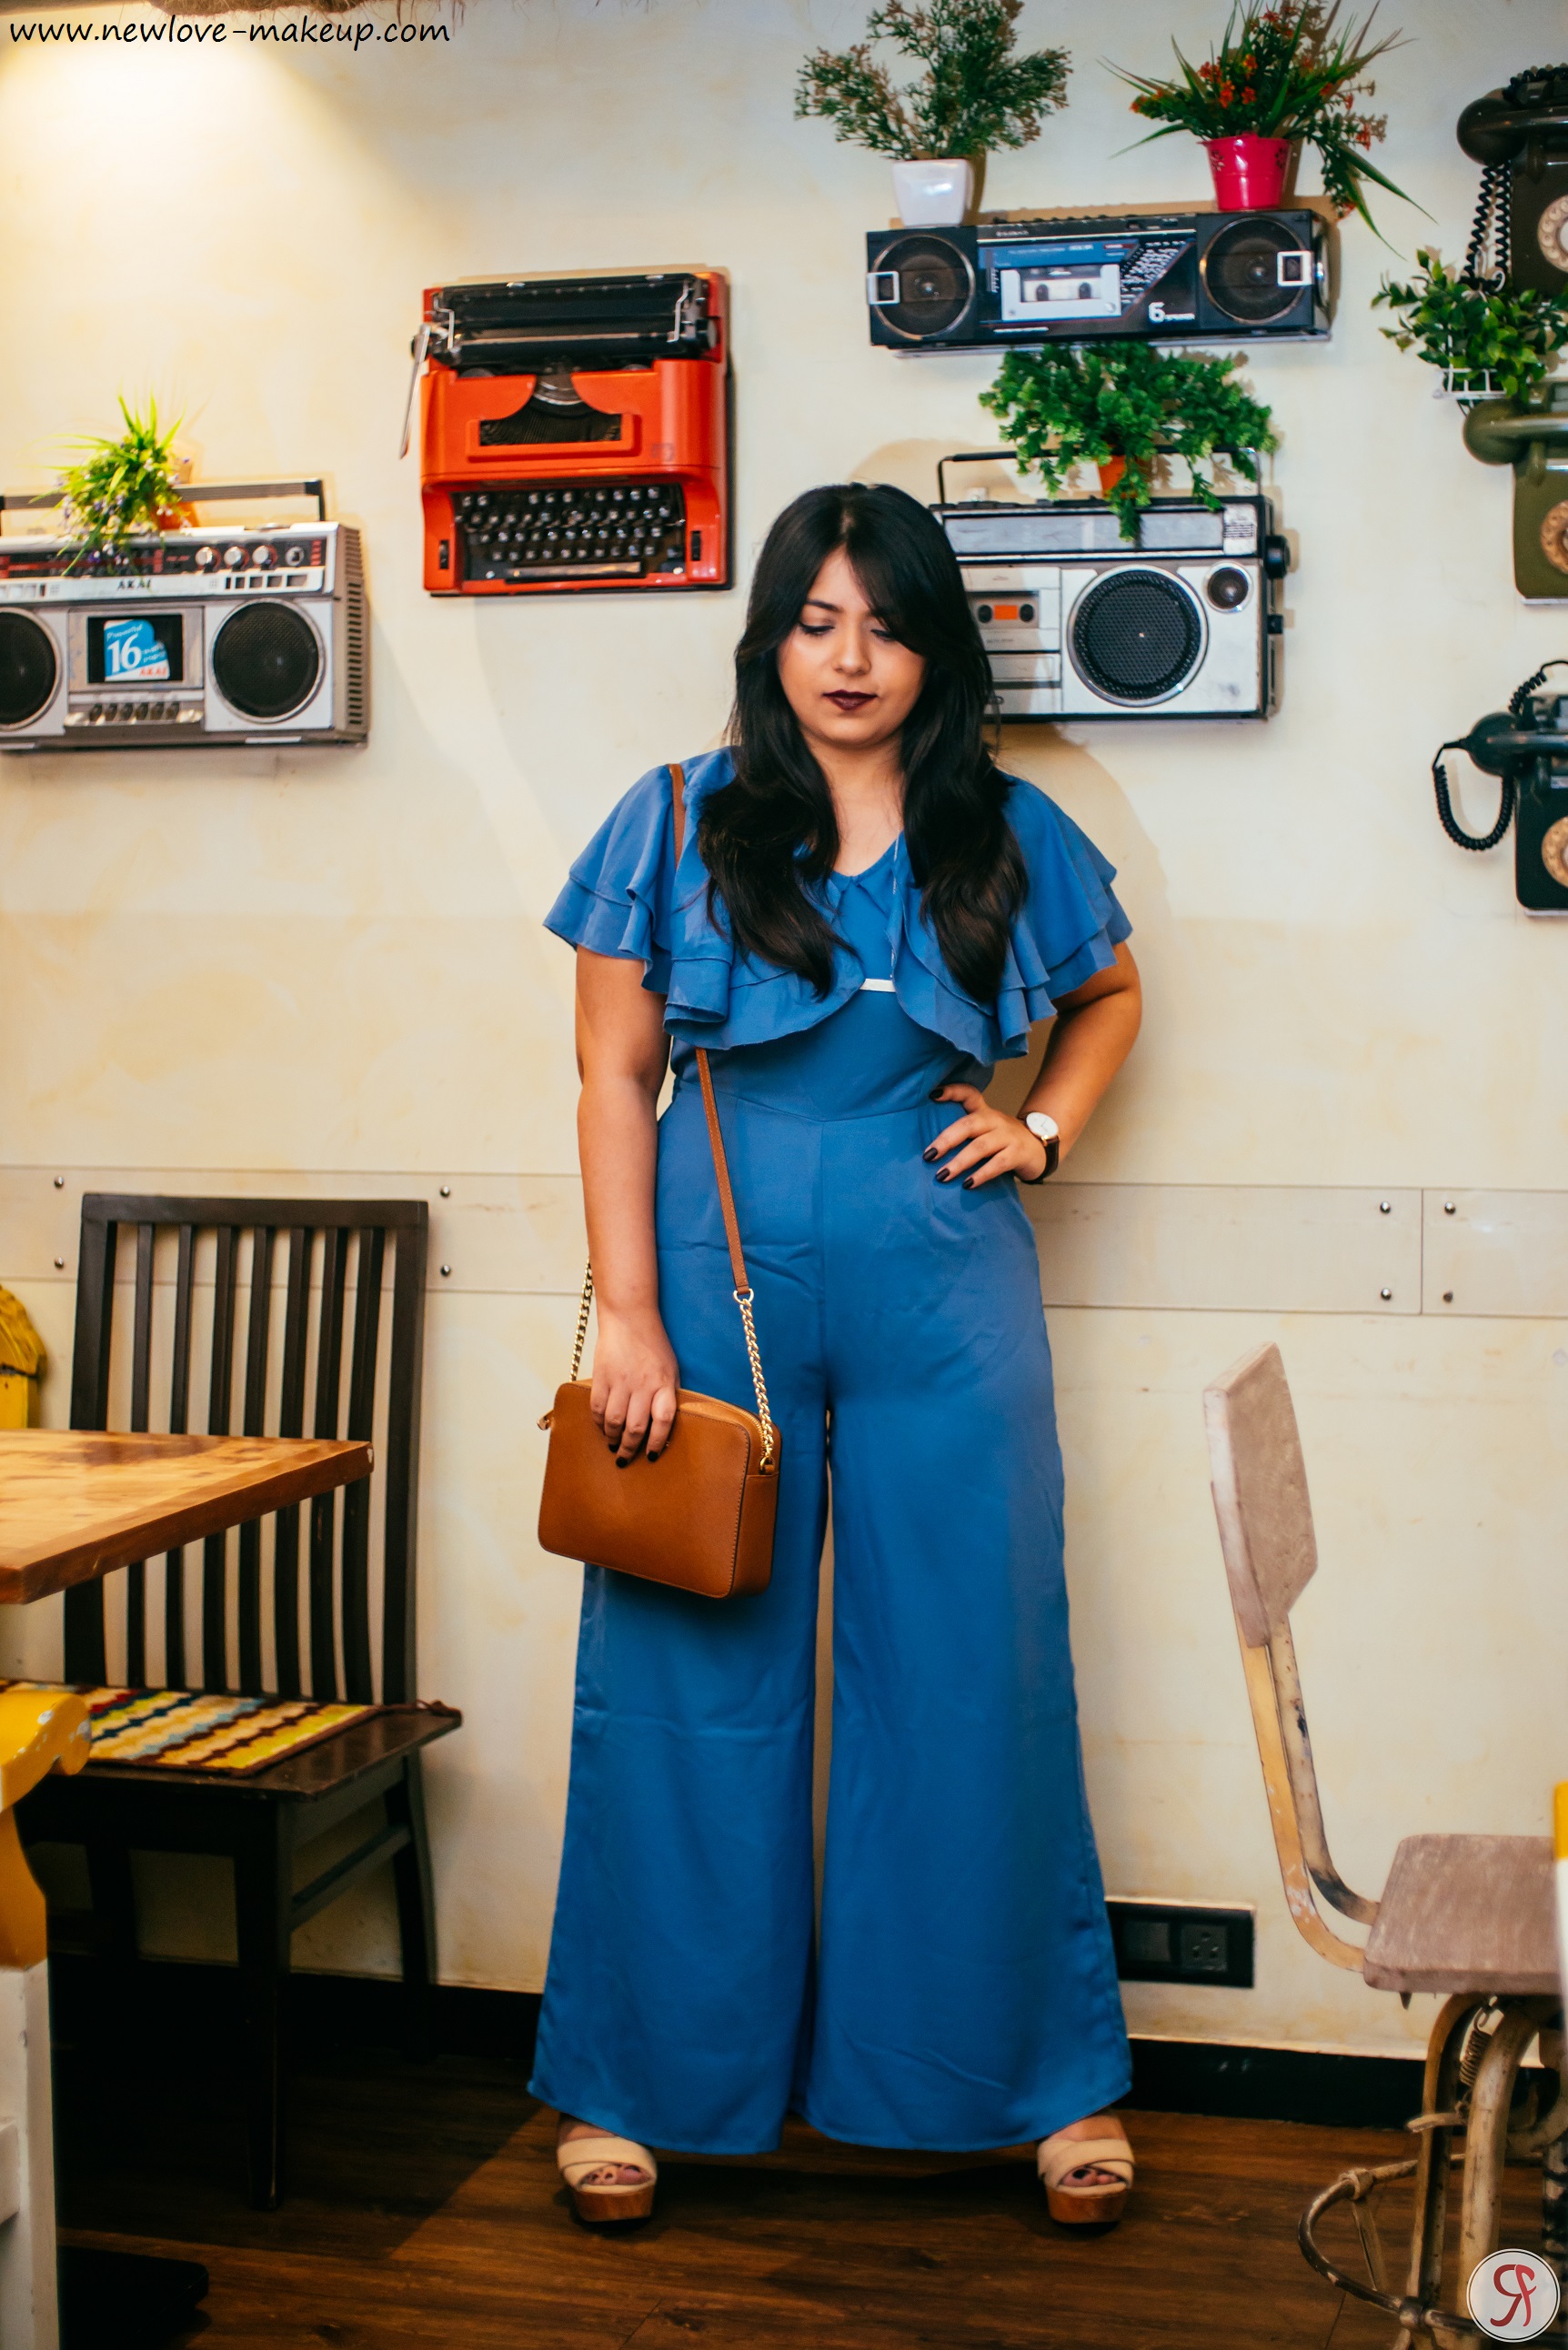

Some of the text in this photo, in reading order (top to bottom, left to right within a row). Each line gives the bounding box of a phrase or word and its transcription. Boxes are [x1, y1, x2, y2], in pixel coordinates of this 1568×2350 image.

[1149, 301, 1165, 322] 6
[117, 578, 151, 589] AKAI
[107, 634, 141, 674] 16
